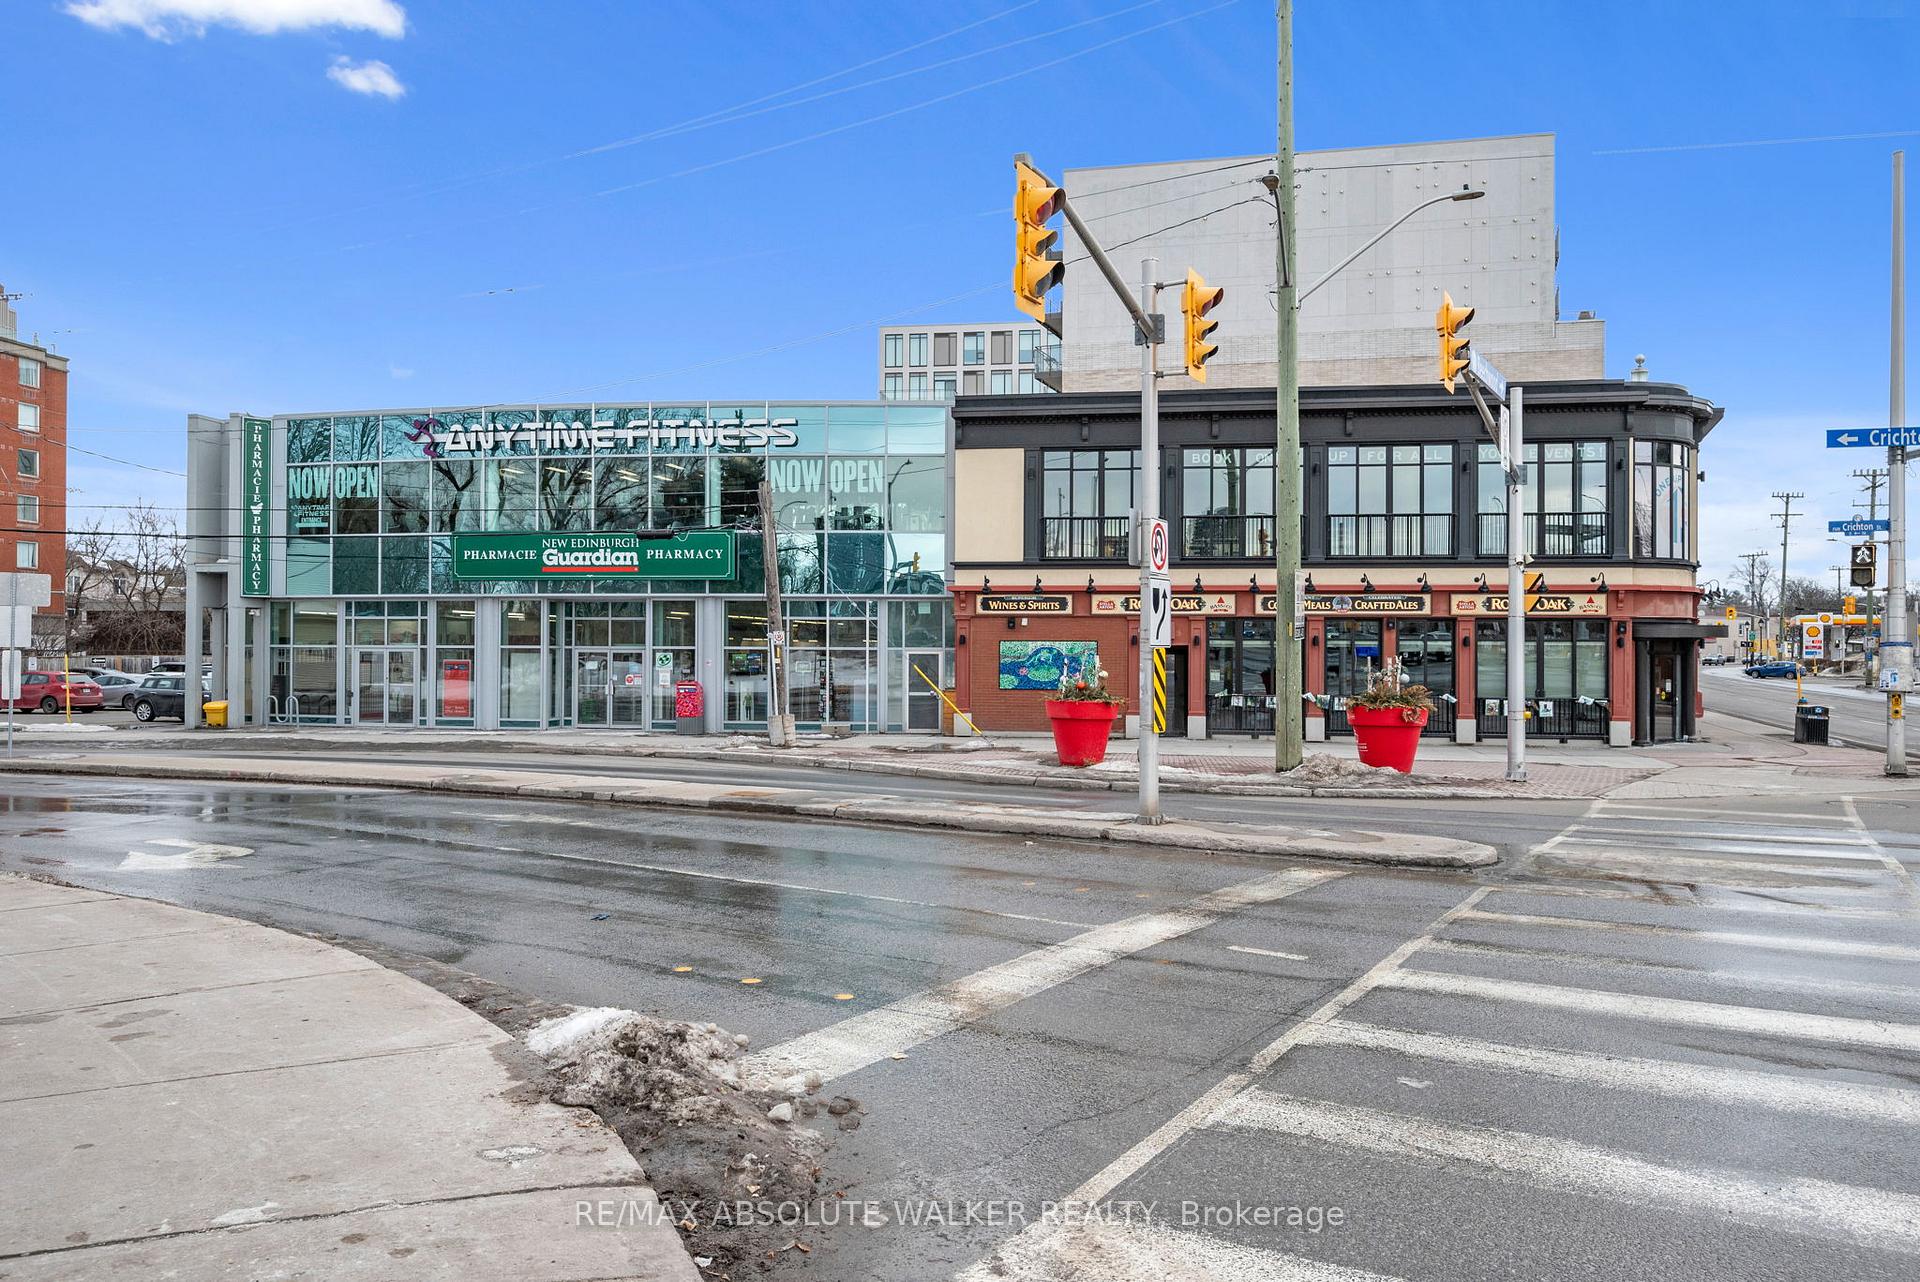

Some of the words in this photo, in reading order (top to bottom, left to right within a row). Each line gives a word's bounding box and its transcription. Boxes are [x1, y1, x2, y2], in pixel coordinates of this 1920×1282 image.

[445, 421, 615, 450] ANYTIME
[627, 418, 798, 447] FITNESS
[1192, 453, 1232, 463] BOOK
[1329, 451, 1348, 461] UP
[1368, 450, 1402, 461] FOR
[1411, 449, 1442, 461] ALL
[252, 425, 263, 502] PHARMACIE
[770, 459, 823, 493] NOW
[830, 460, 883, 493] OPEN
[289, 467, 330, 499] NOW
[335, 466, 378, 498] OPEN
[1842, 522, 1873, 532] Crichton
[542, 538, 568, 548] NEW
[571, 538, 639, 548] EDINBURGH
[251, 516, 261, 590] PHARMACY
[464, 550, 537, 560] PHARMACIE
[542, 548, 639, 565] Guardian
[647, 549, 723, 559] PHARMACY
[989, 601, 1018, 610] WINES
[1019, 601, 1026, 610] &
[1027, 600, 1060, 610] SPIRITS
[1171, 598, 1200, 610] OAK
[1304, 601, 1331, 610] MEALS
[1355, 600, 1395, 610] CRAFTED
[1395, 601, 1419, 610] ALES
[1537, 598, 1568, 610] OAK
